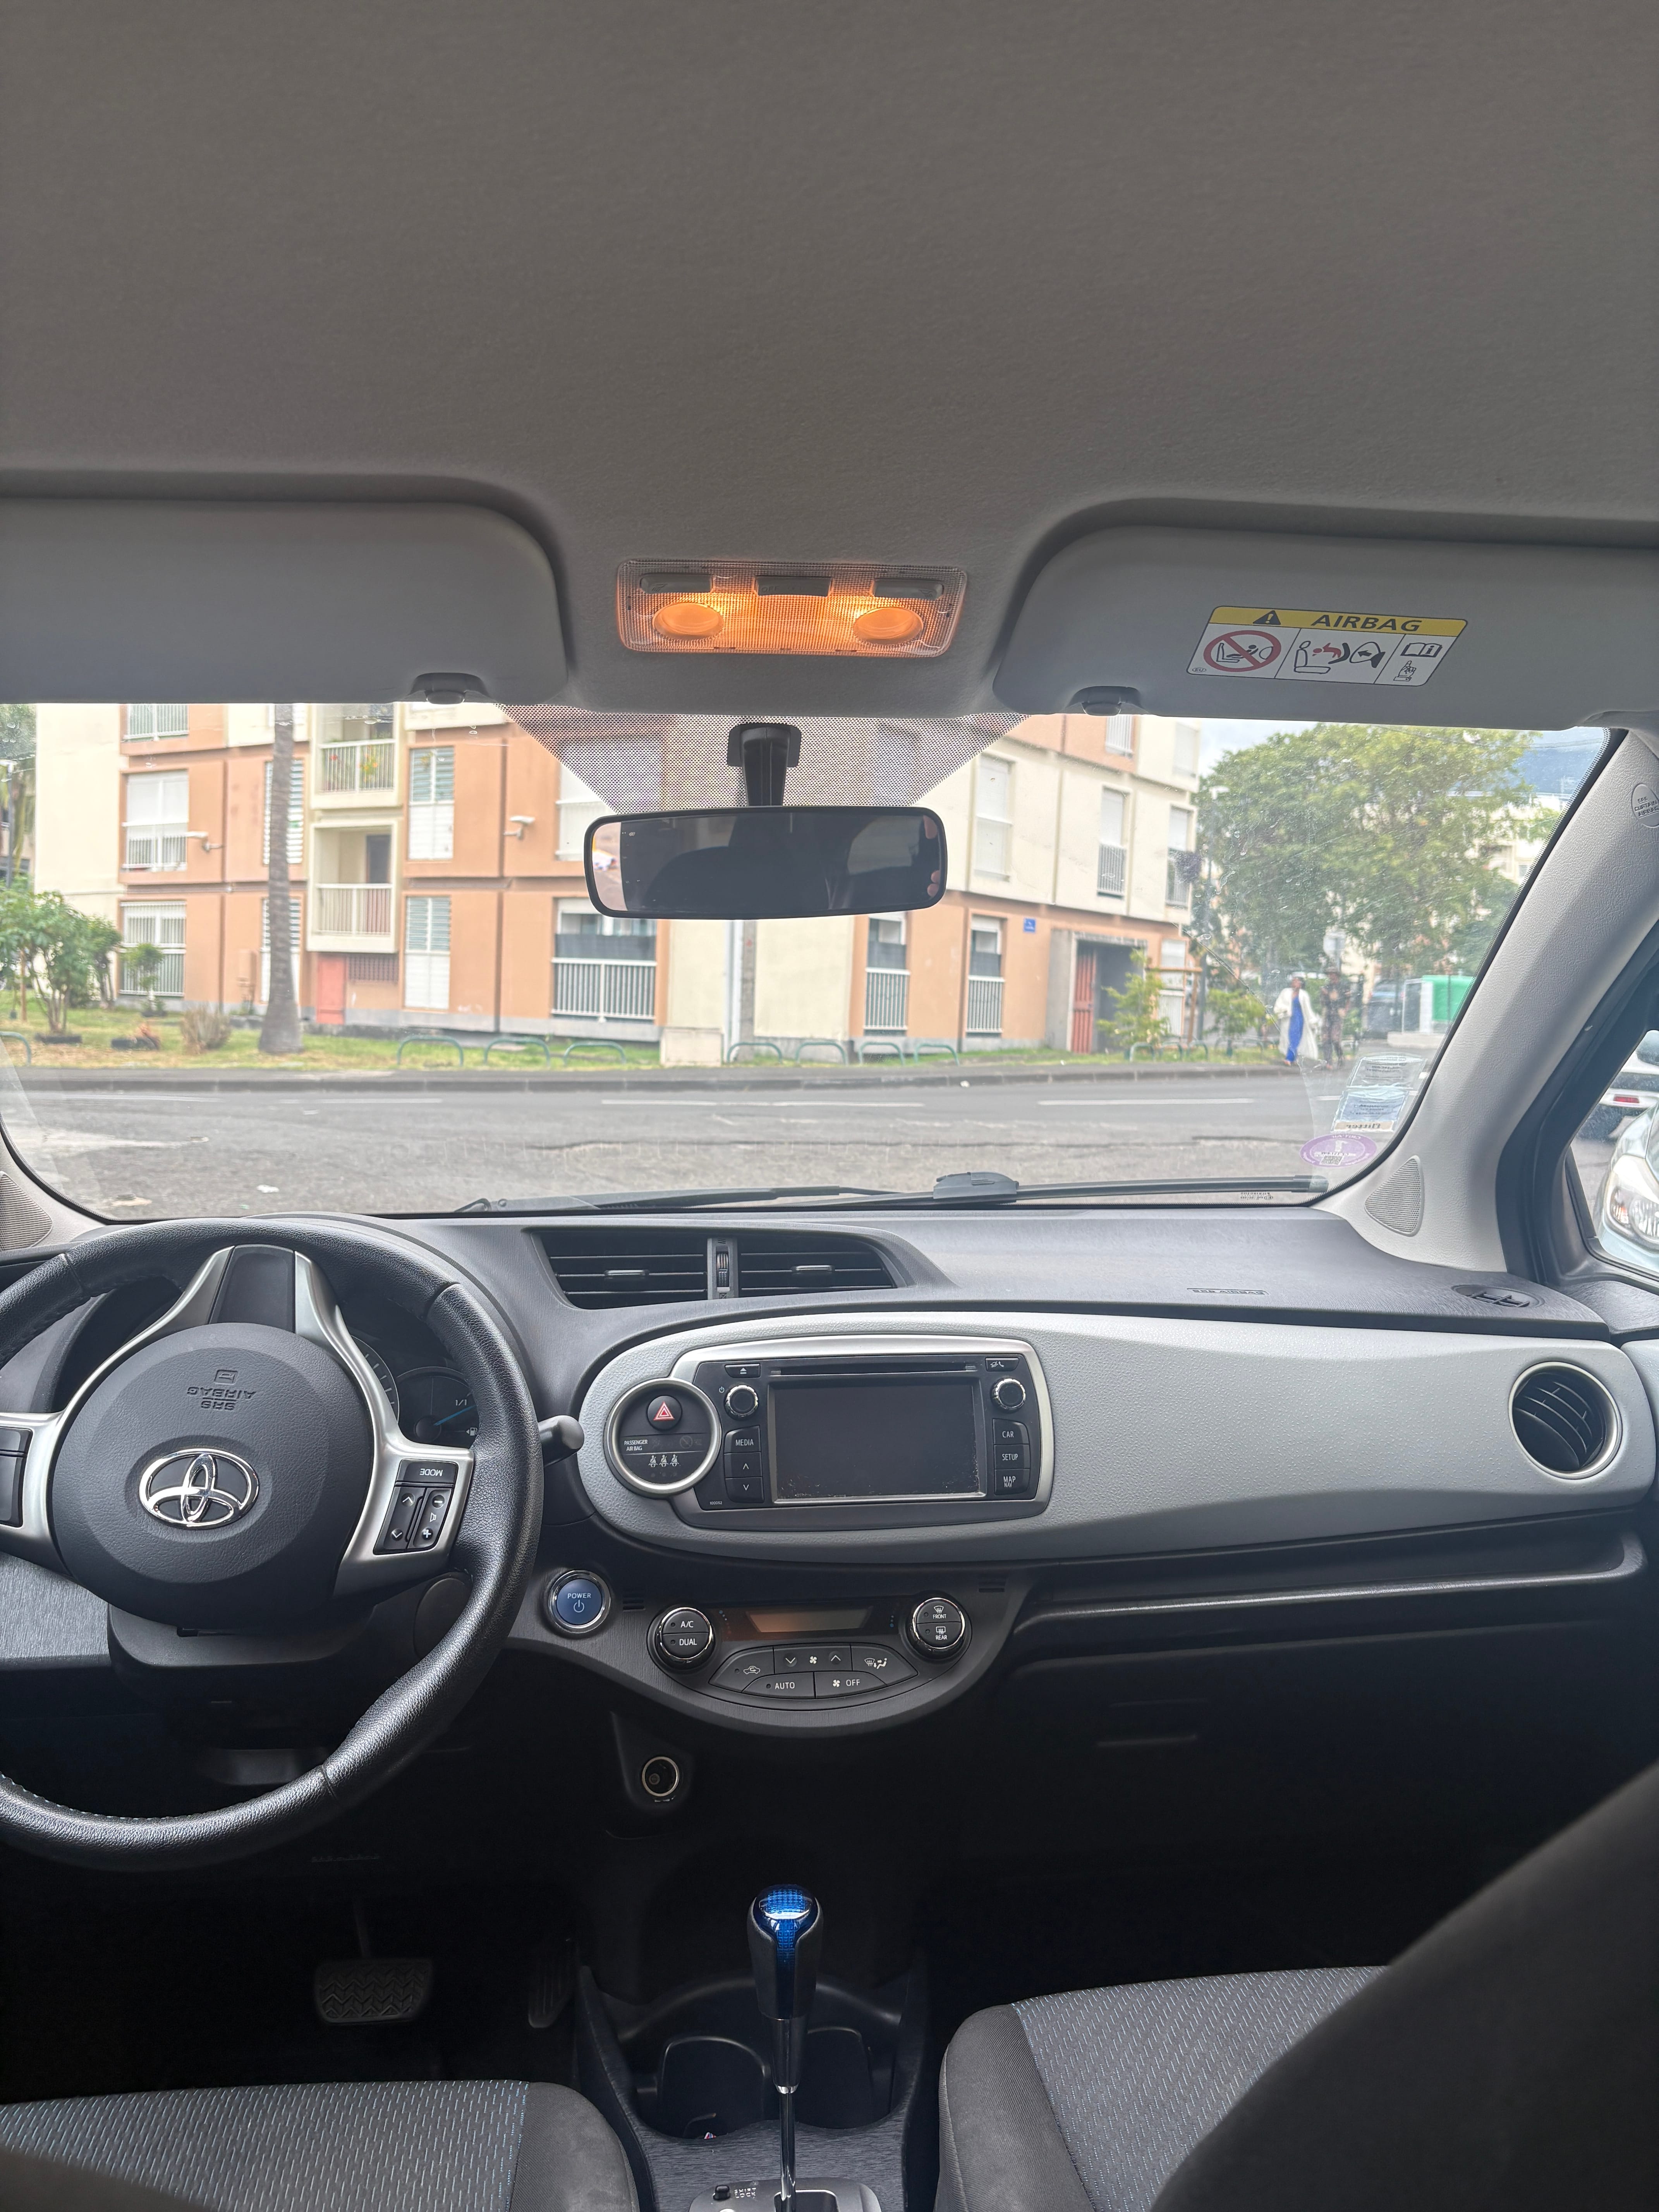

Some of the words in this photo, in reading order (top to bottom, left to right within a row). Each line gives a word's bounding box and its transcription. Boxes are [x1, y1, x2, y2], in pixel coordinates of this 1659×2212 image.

[1310, 614, 1422, 632] AIRBAG
[187, 1387, 256, 1400] AIRBAG
[201, 1400, 235, 1411] SRS
[419, 1468, 443, 1477] MODE
[775, 1681, 795, 1690] AUTO
